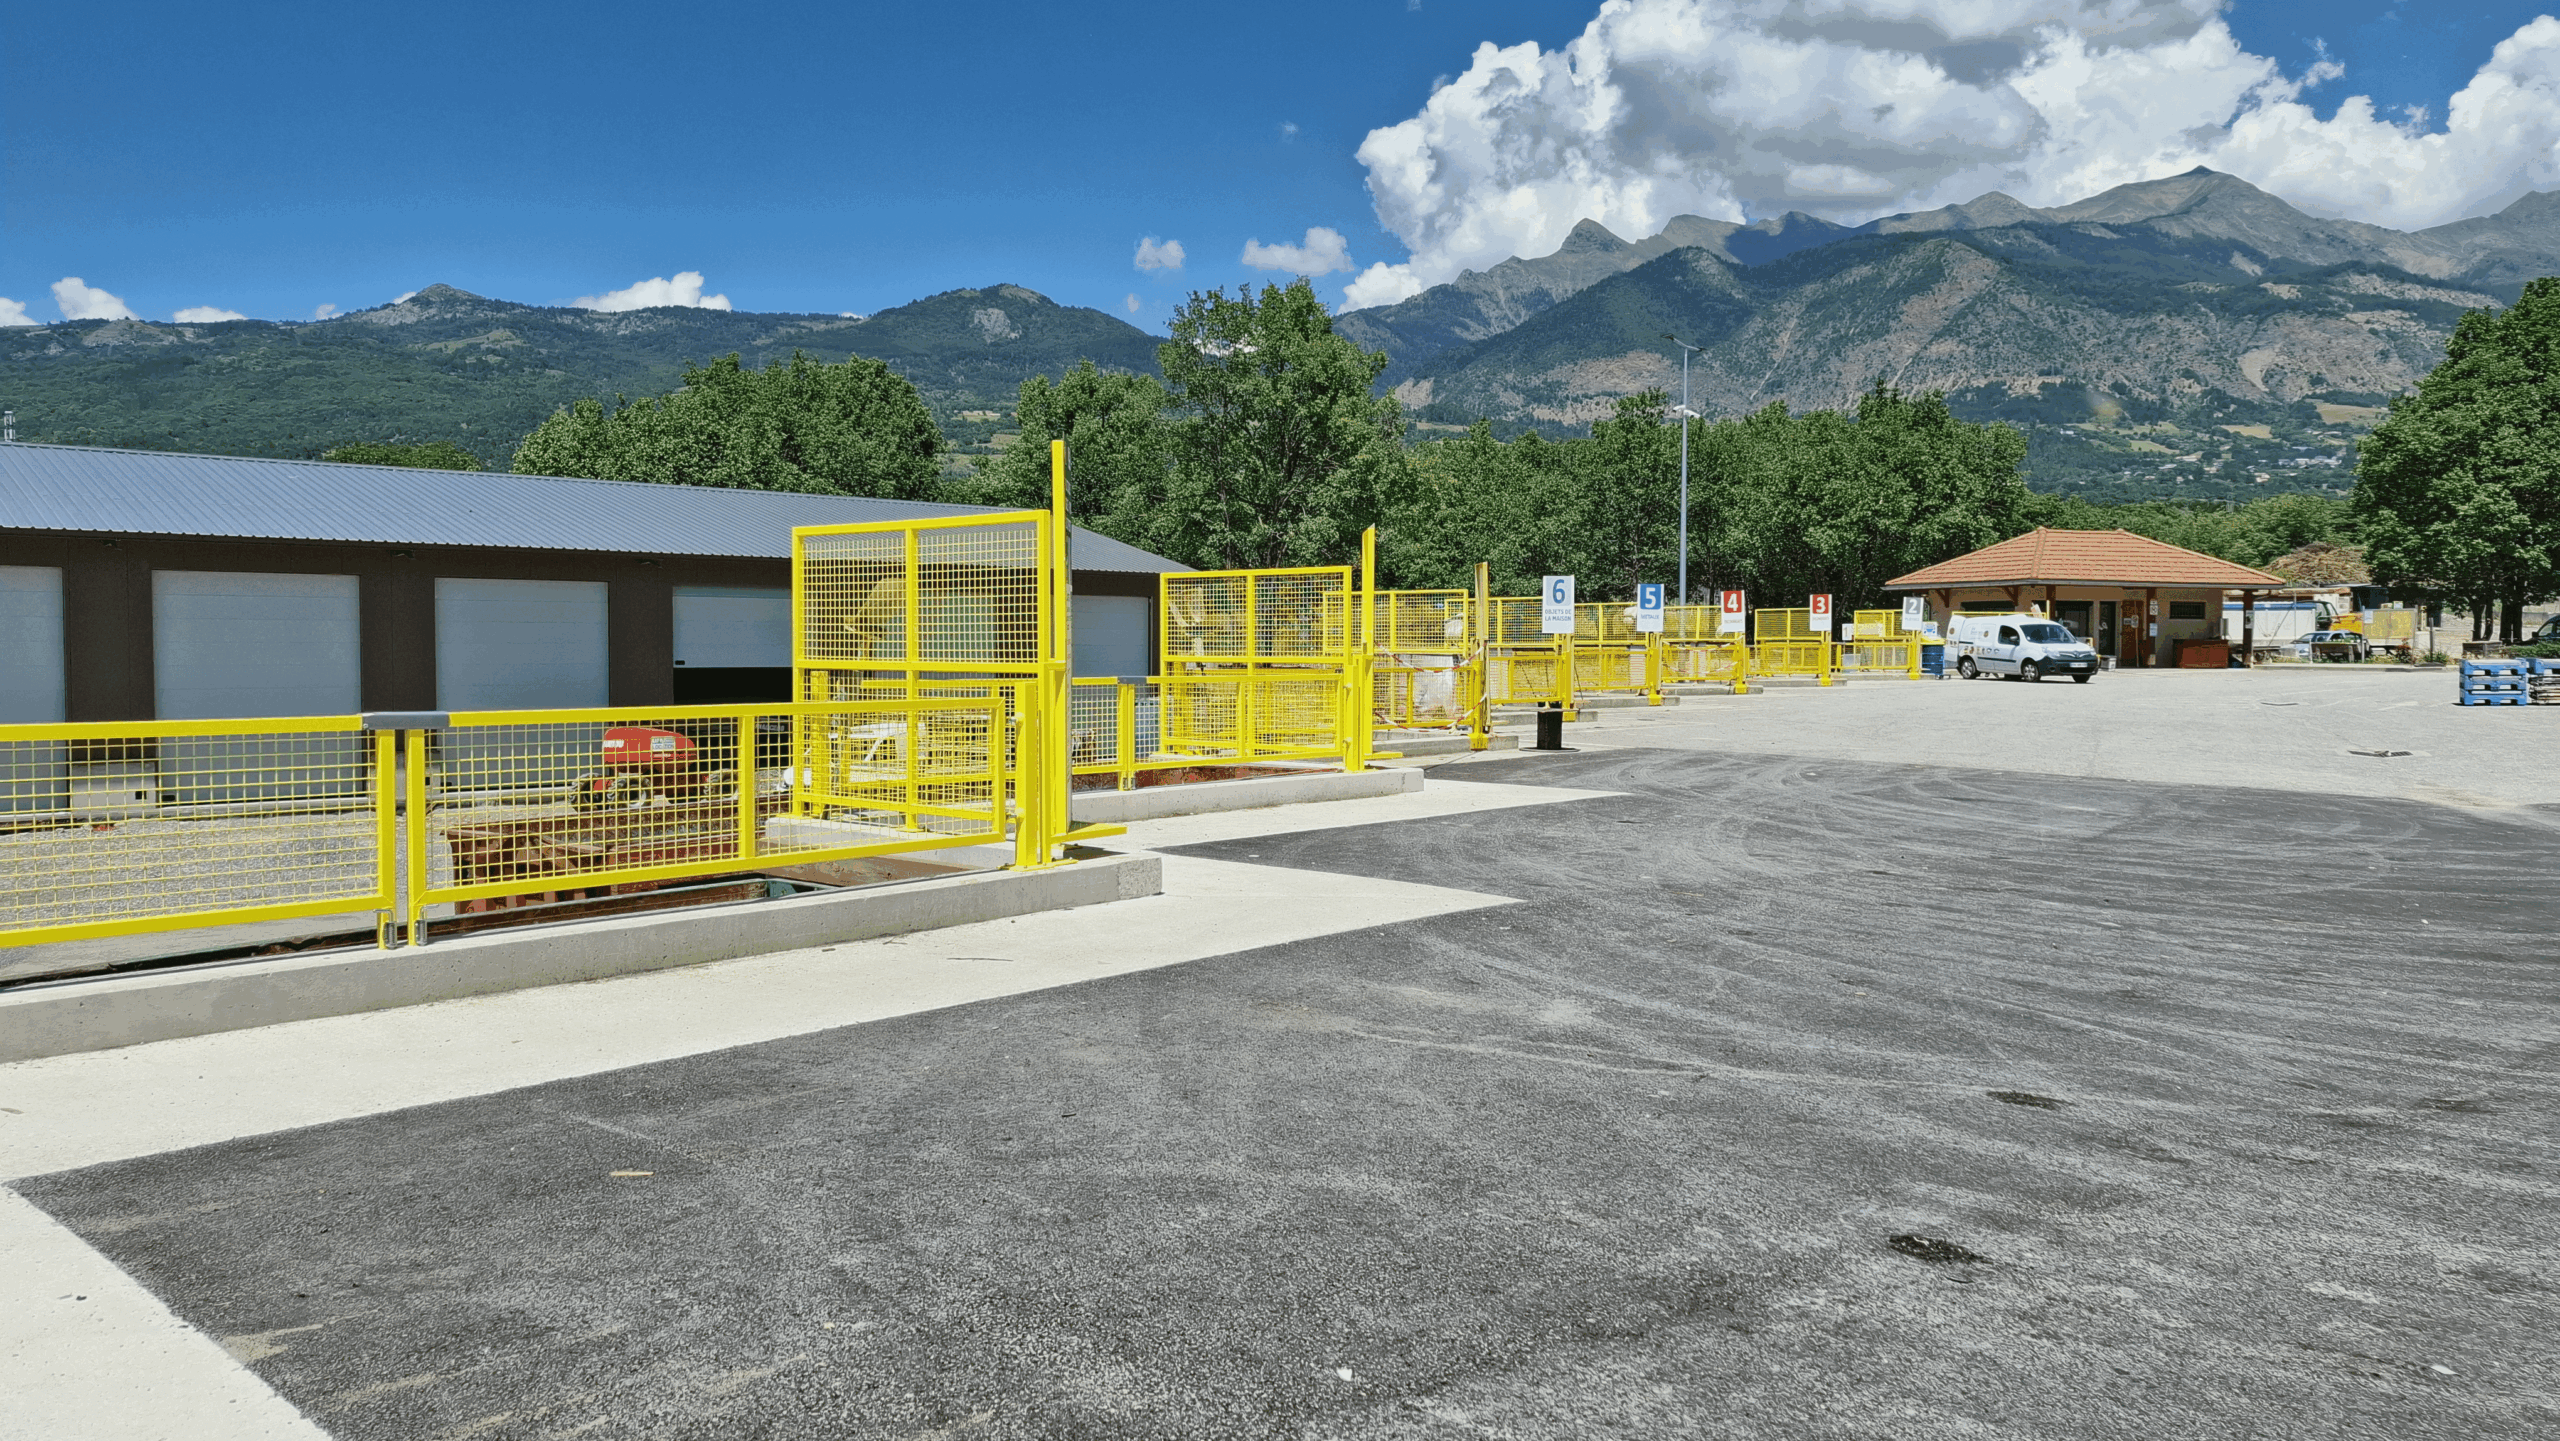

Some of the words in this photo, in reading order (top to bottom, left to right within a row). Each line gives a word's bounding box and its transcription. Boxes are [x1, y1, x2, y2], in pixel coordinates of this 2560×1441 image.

[1552, 578, 1566, 604] 6
[1645, 587, 1657, 609] 5
[1727, 592, 1739, 612] 4
[1815, 596, 1827, 613] 3
[1908, 598, 1918, 614] 2
